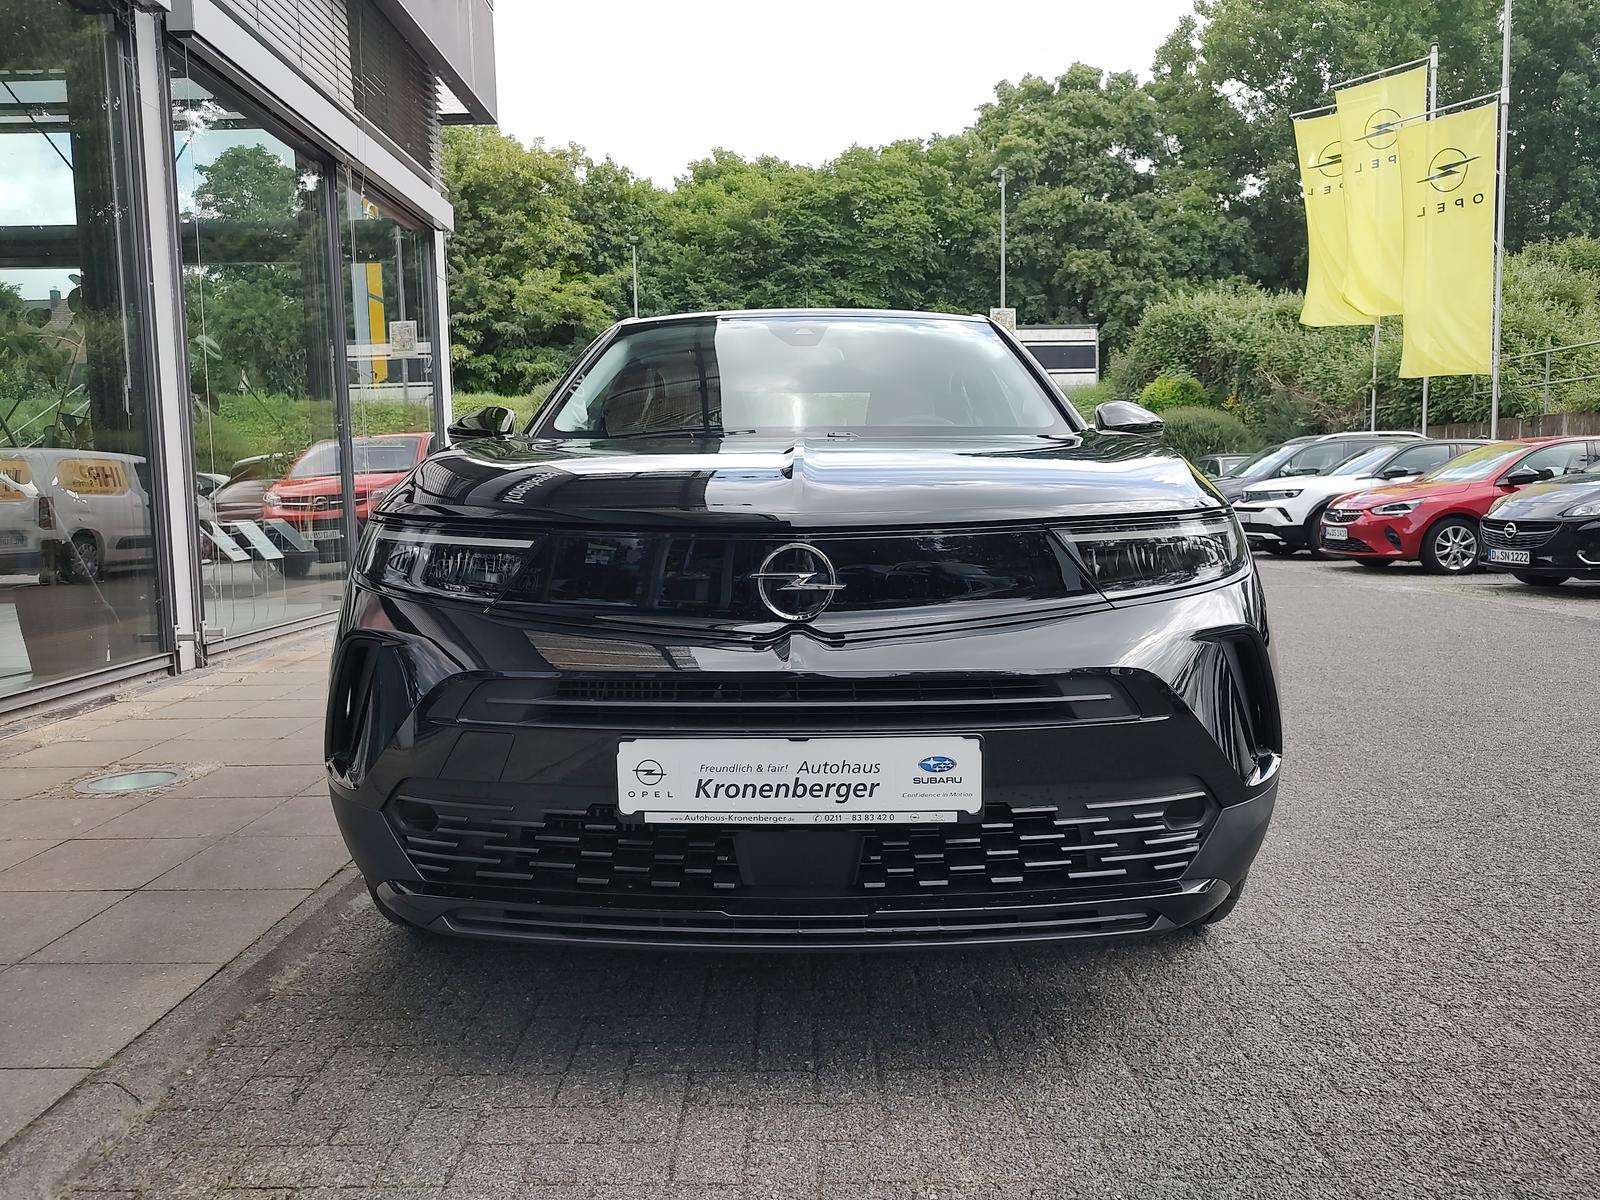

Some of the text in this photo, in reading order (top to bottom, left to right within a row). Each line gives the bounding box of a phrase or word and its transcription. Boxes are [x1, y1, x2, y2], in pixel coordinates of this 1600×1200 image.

[699, 760, 881, 774] Freundlich & fair! Autohaus
[695, 777, 881, 804] Kronenberger
[864, 814, 875, 822] 83
